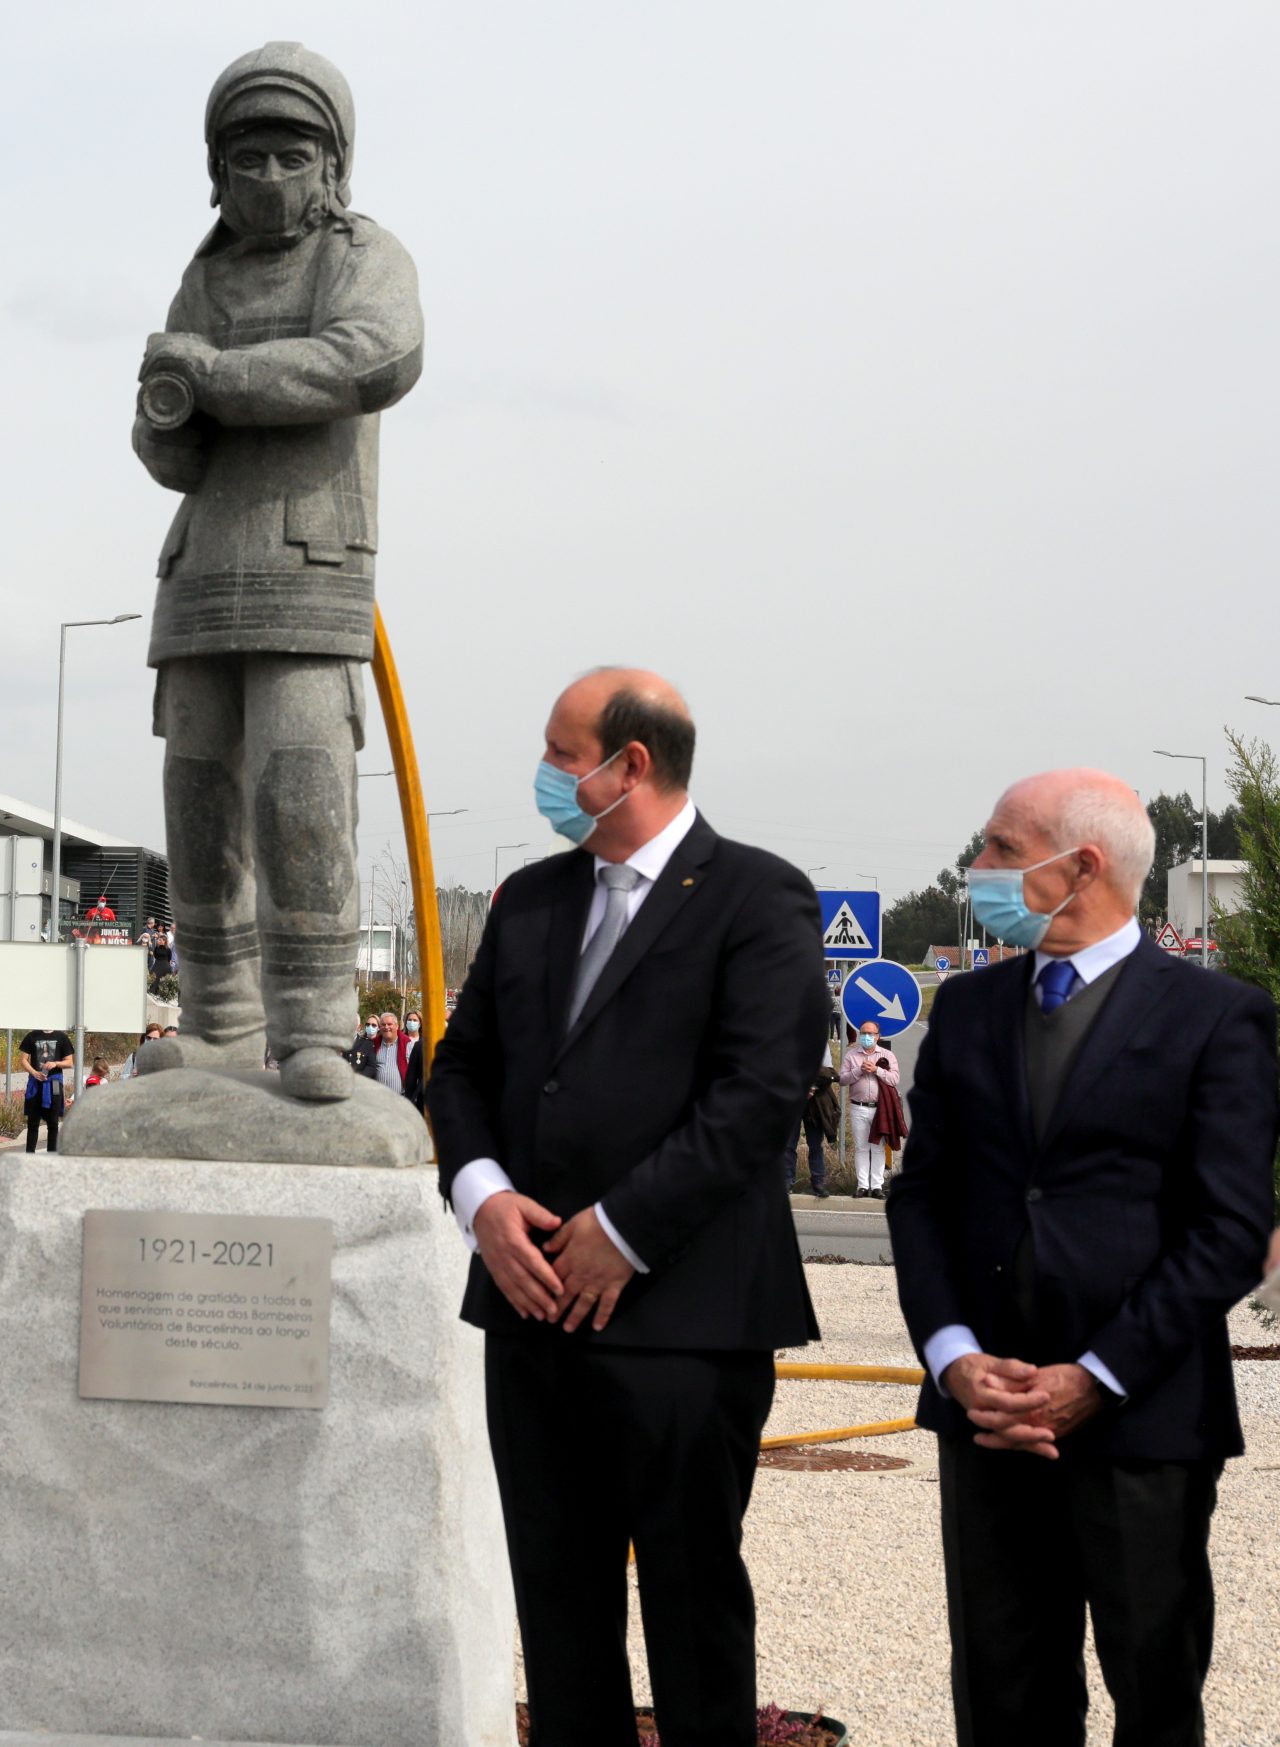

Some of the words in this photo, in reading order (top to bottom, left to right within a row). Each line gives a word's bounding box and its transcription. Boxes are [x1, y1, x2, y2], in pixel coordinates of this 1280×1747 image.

[101, 928, 129, 936] JUNTA-TE
[139, 1238, 274, 1267] 1921-2021
[96, 1288, 174, 1302] Homenagem
[177, 1292, 193, 1302] de
[197, 1292, 247, 1305] gratidão
[263, 1295, 296, 1306] todos
[98, 1305, 121, 1315] que
[124, 1305, 173, 1316] serviram
[187, 1308, 224, 1318] causa
[227, 1309, 248, 1320] dos
[252, 1310, 313, 1322] Bombeiros
[99, 1319, 163, 1331] Voluntários
[166, 1322, 183, 1332] de
[186, 1322, 253, 1336] Barcelinhos
[256, 1327, 273, 1336] ao
[276, 1326, 310, 1340] longo
[165, 1337, 198, 1348] deste
